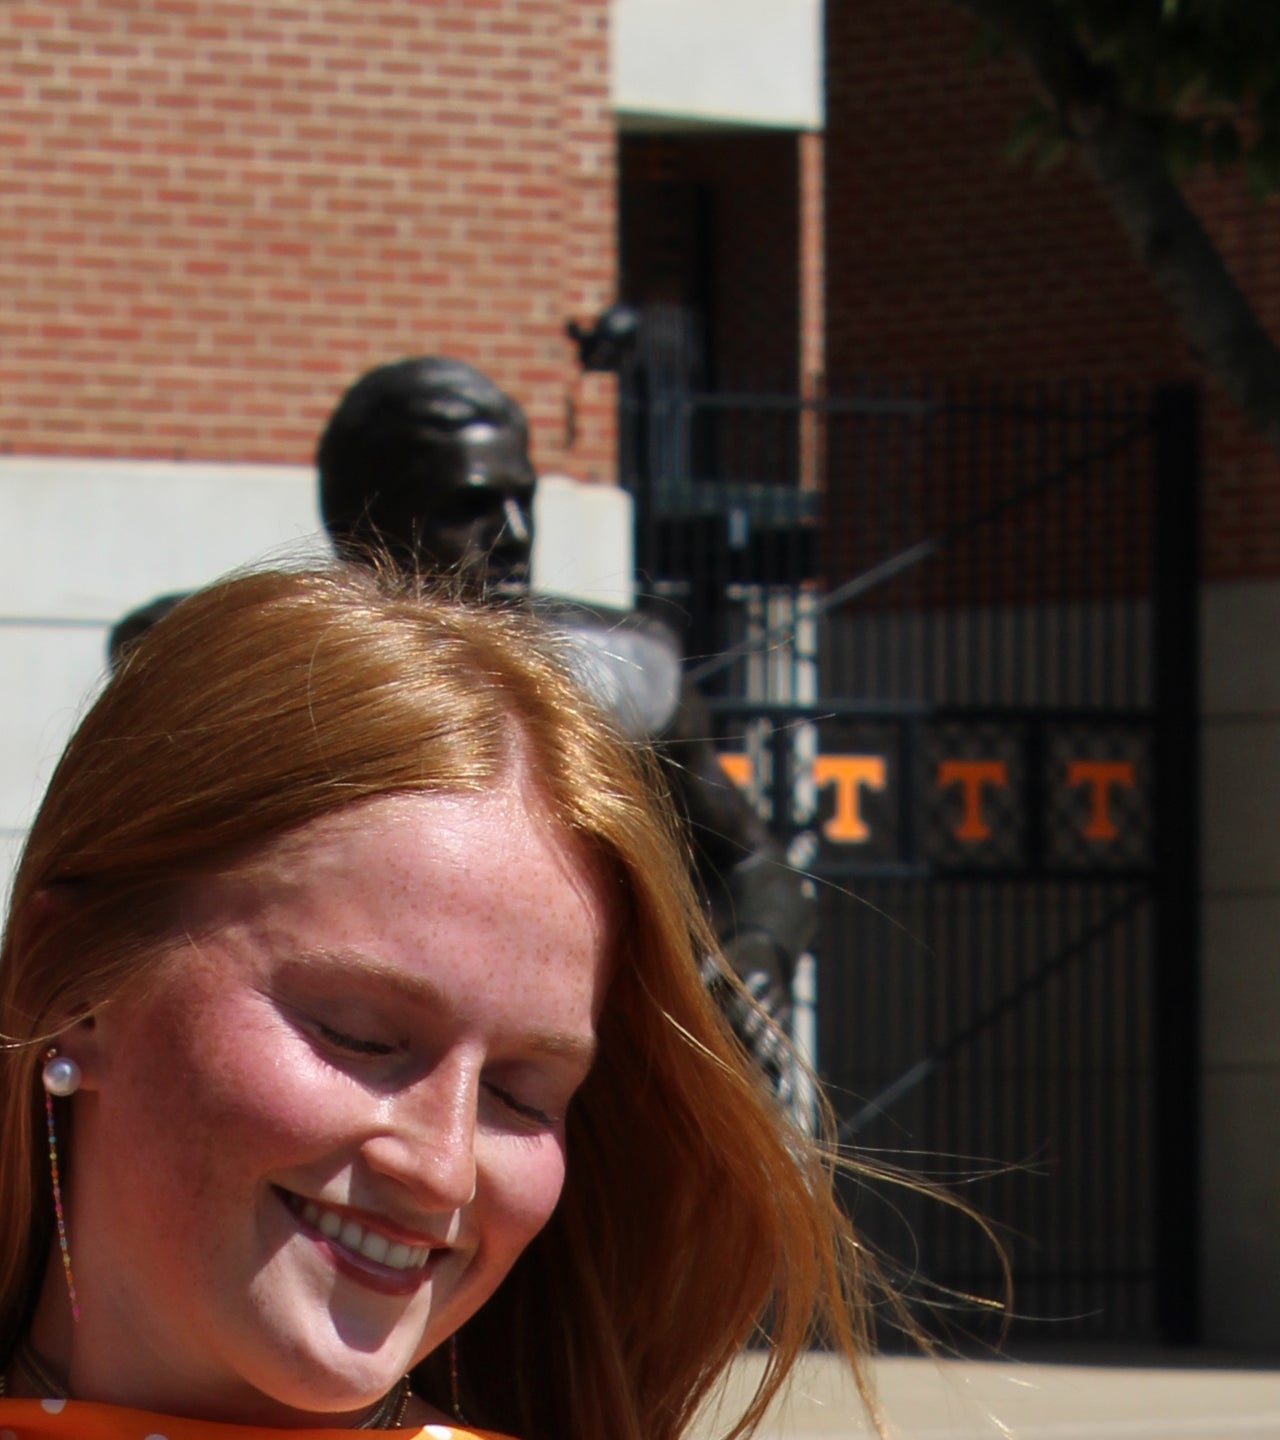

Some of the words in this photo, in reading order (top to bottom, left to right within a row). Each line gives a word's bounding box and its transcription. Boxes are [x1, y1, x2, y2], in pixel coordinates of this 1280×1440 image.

[812, 753, 887, 842] T
[937, 759, 1008, 841] T
[1067, 760, 1135, 840] T
